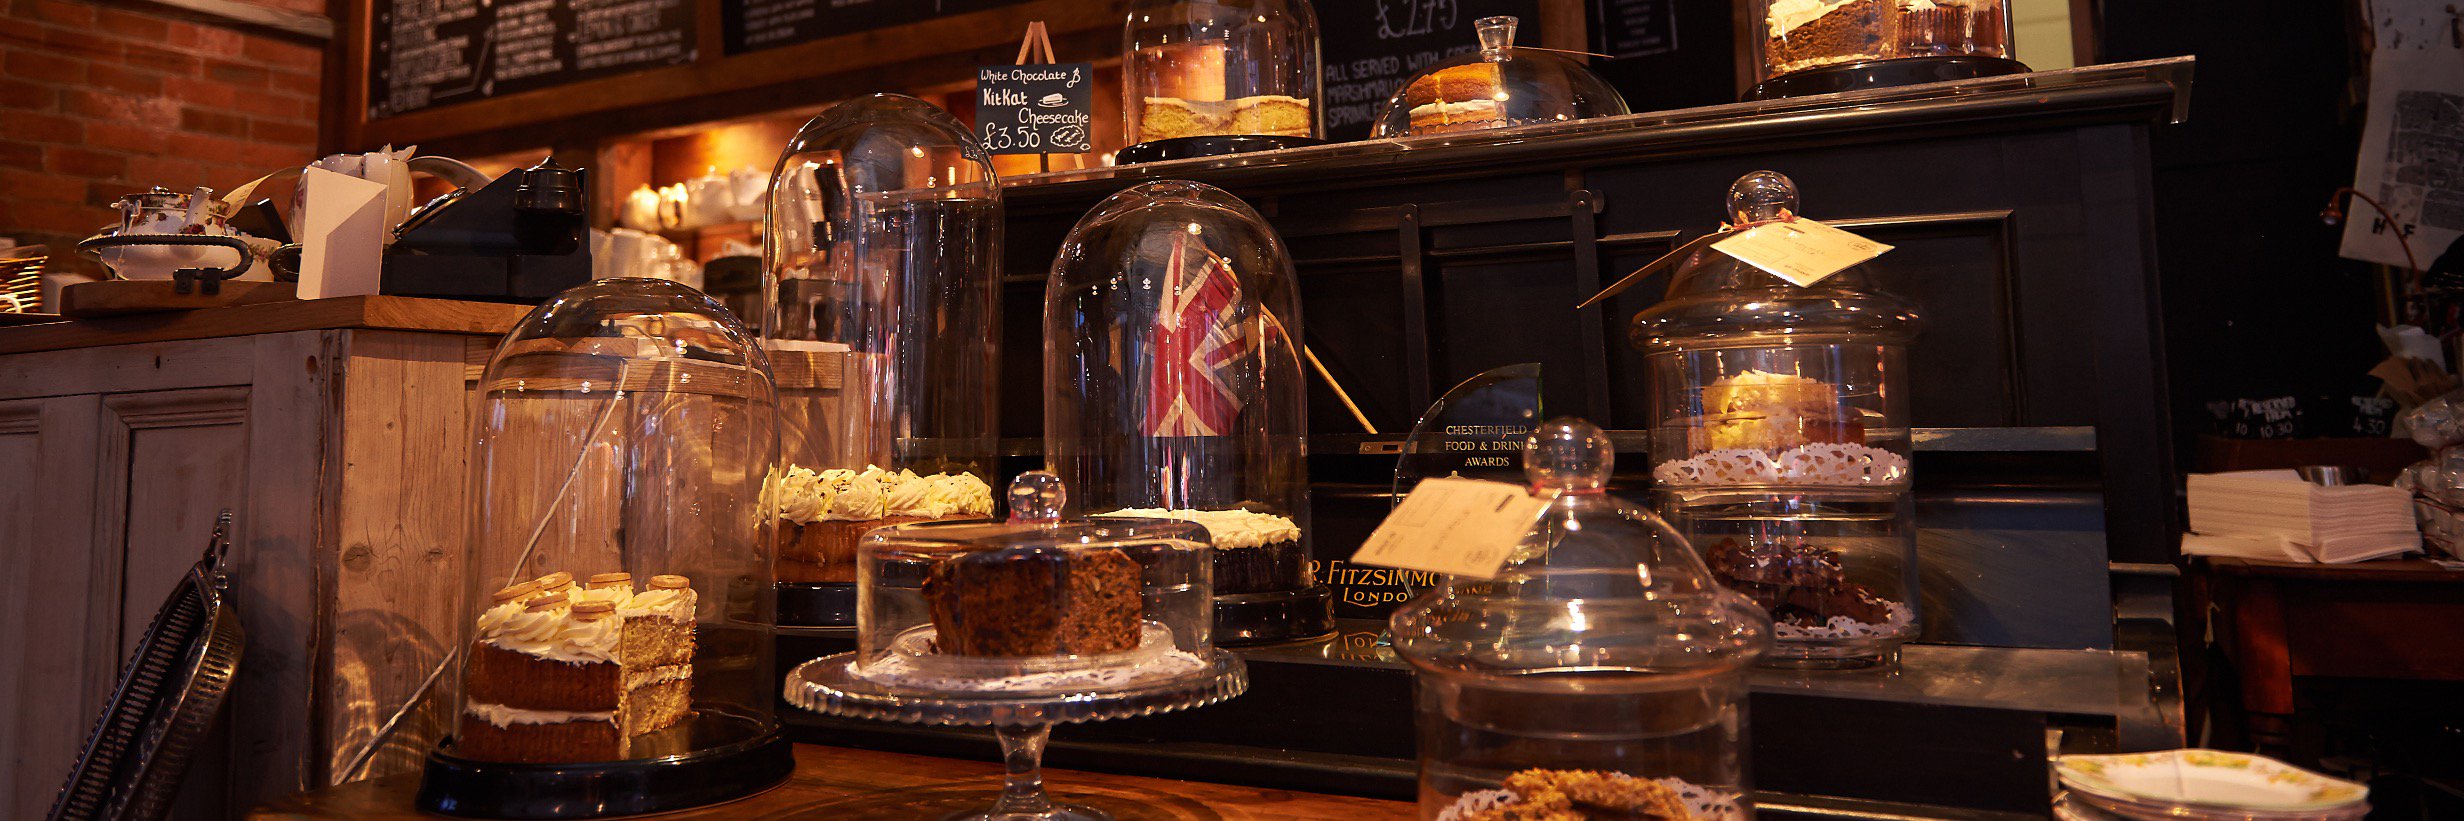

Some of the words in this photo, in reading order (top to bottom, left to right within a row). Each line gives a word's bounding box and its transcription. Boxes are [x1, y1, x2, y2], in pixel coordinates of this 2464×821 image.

[980, 69, 1008, 84] White
[1011, 69, 1067, 85] Chocolate
[1351, 55, 1400, 80] SERVED
[983, 88, 1028, 107] KitKat
[1018, 107, 1089, 131] Cheesecake
[982, 122, 1041, 150] £3.50
[1445, 425, 1528, 436] CHESTERFIELD
[1445, 440, 1476, 451] FOOD
[1480, 441, 1488, 451] &
[1464, 456, 1510, 467] AWARDS
[1343, 587, 1408, 606] LONDO
